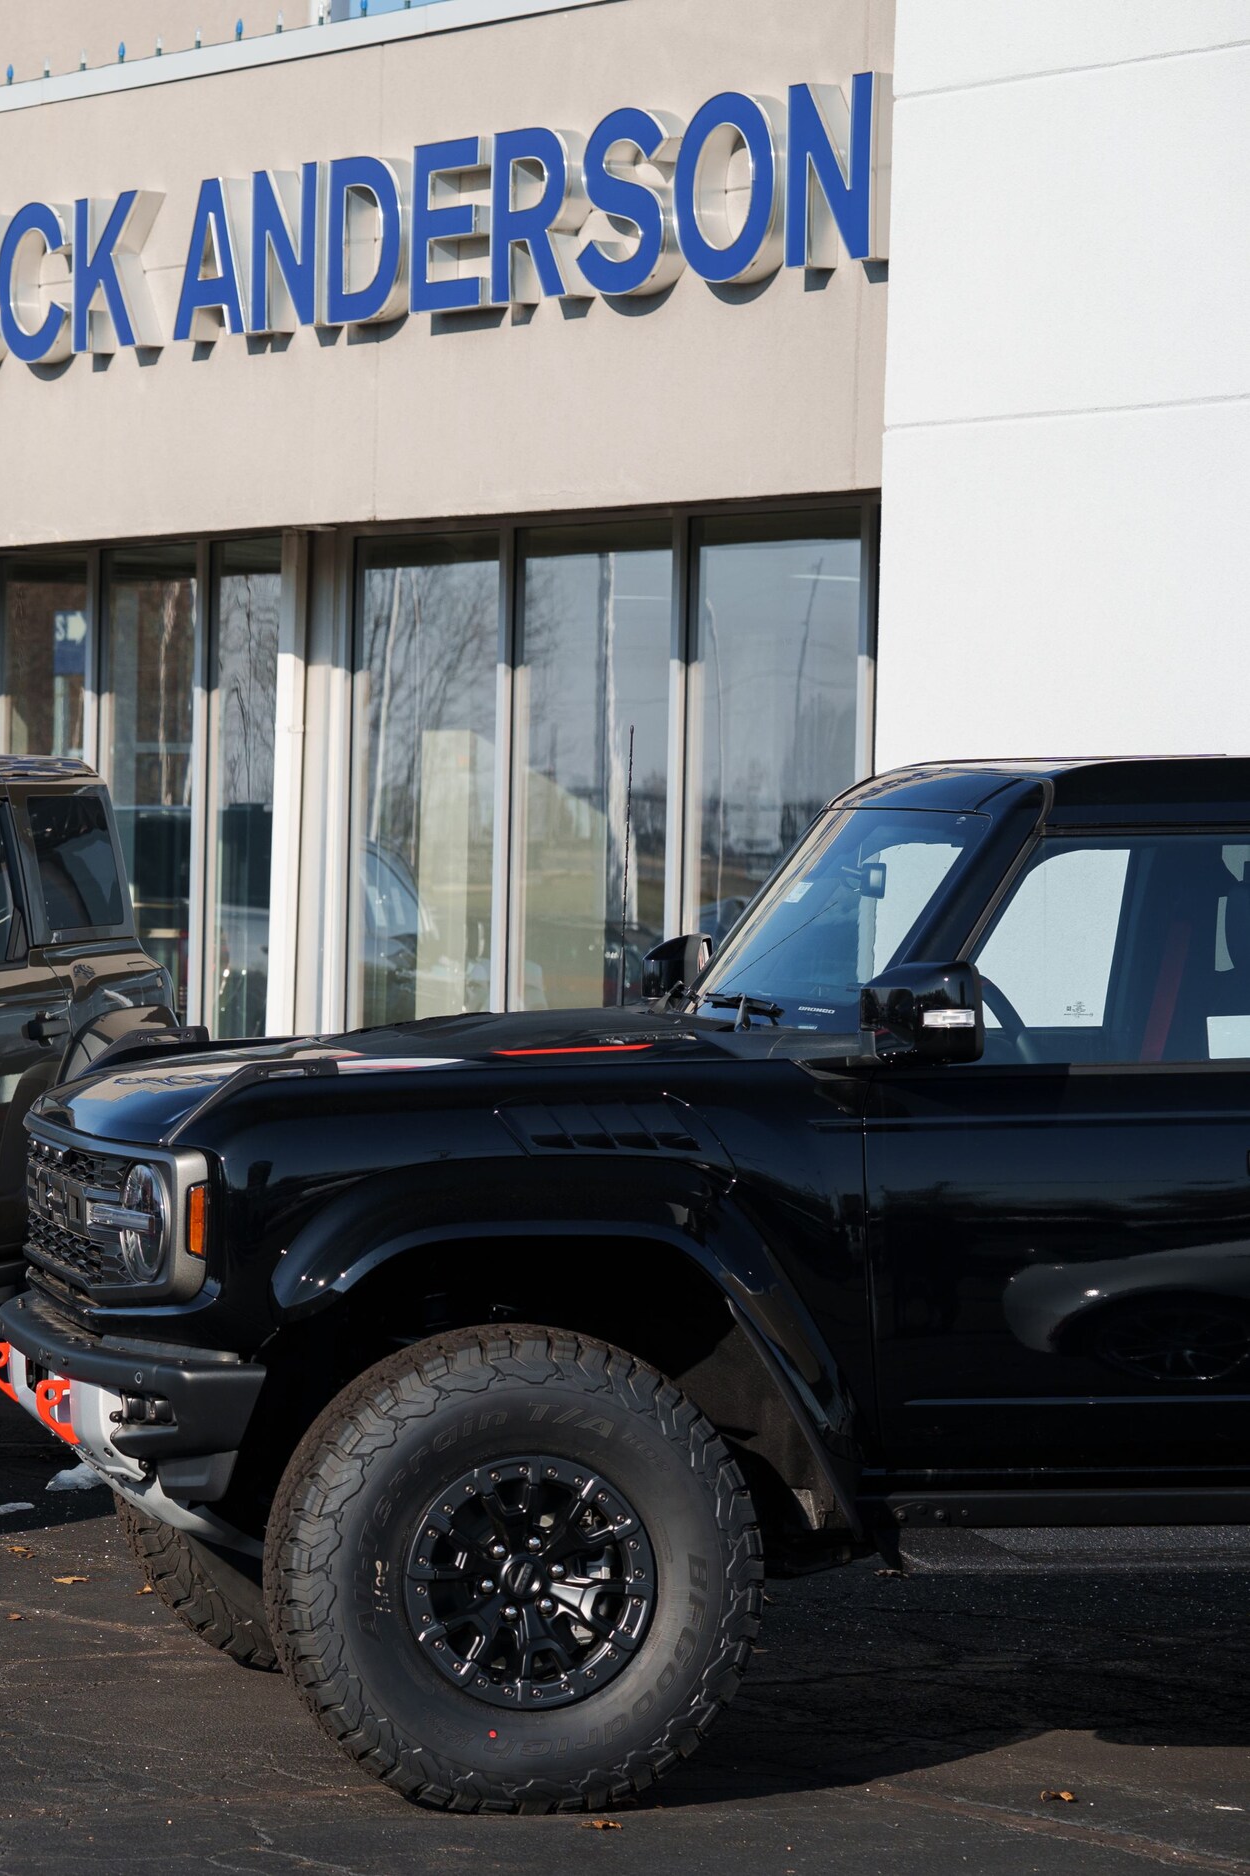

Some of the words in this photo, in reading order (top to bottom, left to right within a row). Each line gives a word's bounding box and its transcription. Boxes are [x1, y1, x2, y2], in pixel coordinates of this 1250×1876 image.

[172, 70, 878, 342] ANDERSON
[528, 1402, 616, 1439] T/A
[482, 1552, 711, 1762] BFGoodrich
